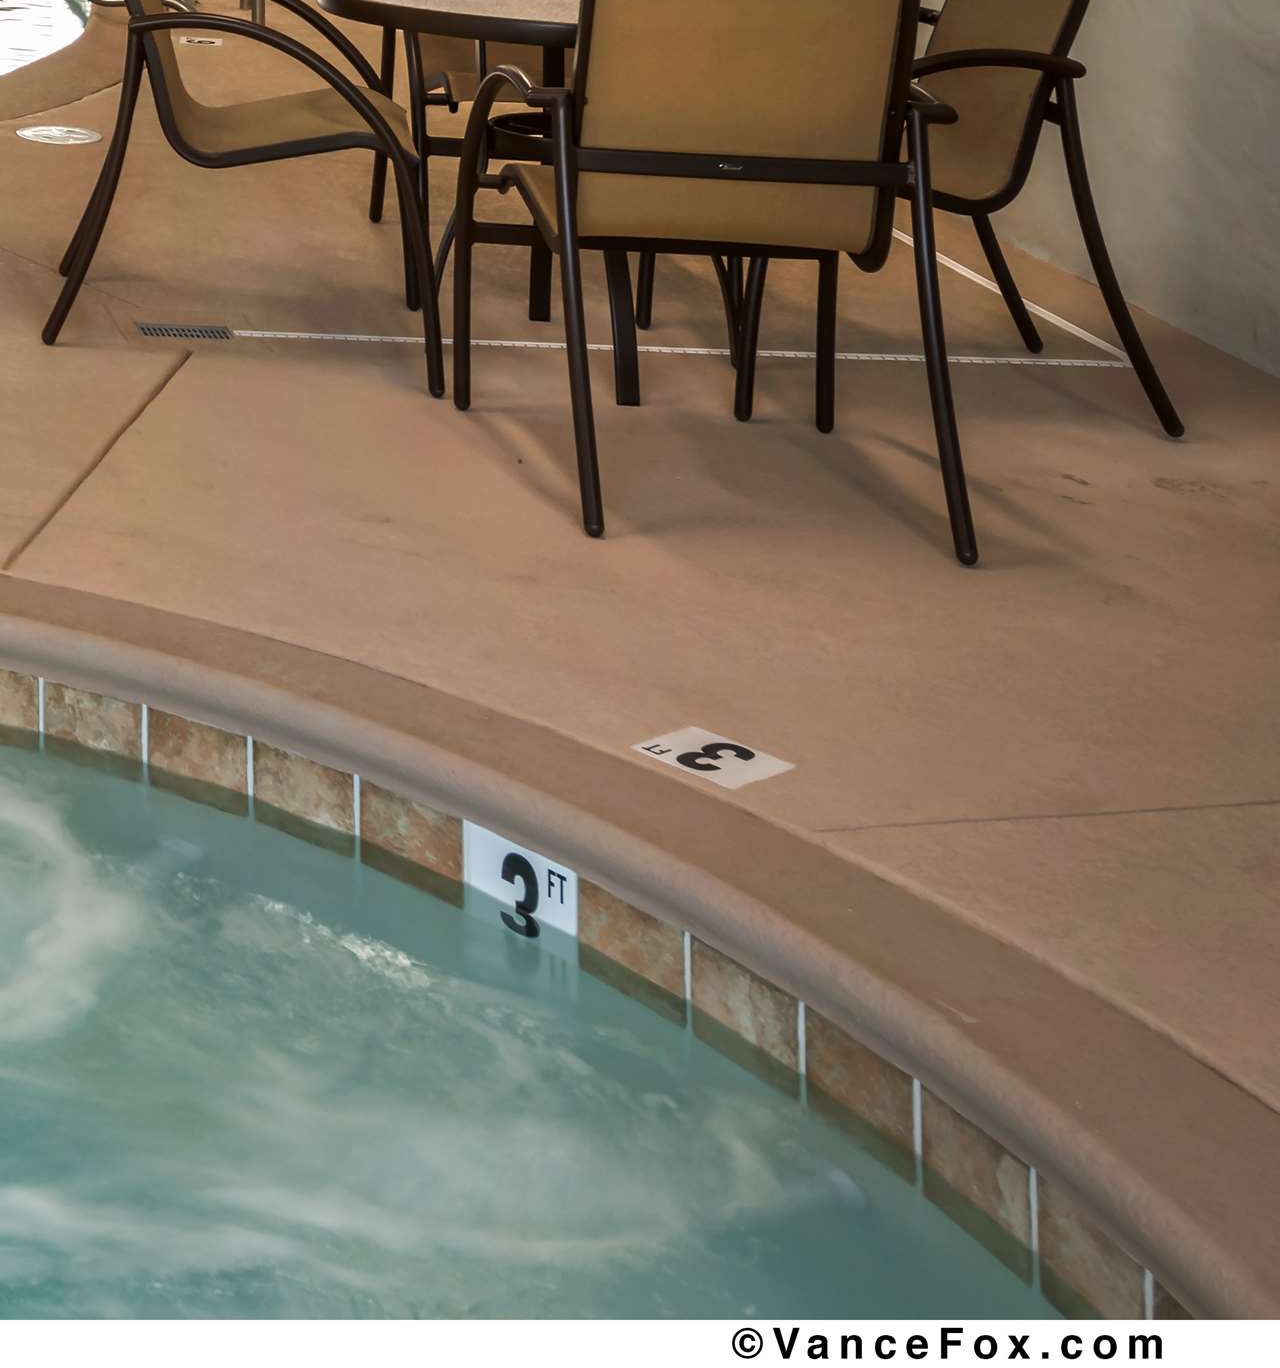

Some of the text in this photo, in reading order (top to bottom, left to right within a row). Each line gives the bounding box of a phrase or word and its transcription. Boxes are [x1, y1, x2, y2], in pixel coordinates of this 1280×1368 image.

[641, 742, 756, 771] 3 FT
[500, 852, 567, 938] 3 FT
